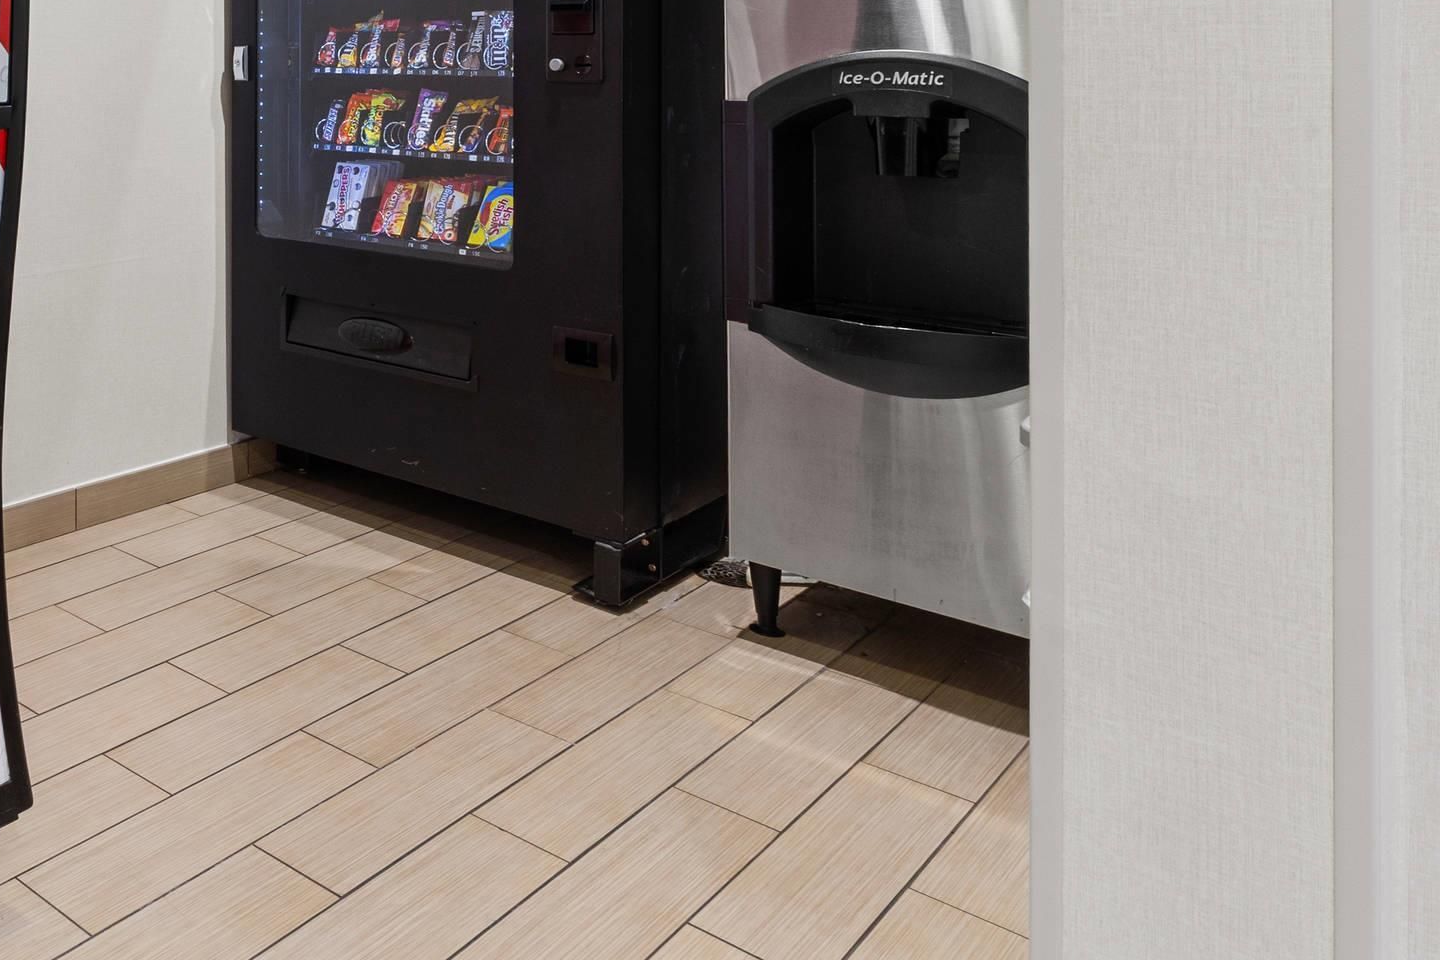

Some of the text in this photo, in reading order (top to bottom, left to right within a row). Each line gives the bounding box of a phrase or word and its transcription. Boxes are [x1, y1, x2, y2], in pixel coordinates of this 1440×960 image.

[839, 71, 945, 86] Ice-O-Matic
[334, 166, 351, 224] WHOPPERS
[435, 184, 454, 208] Dough
[487, 198, 509, 236] Swedish
[498, 206, 513, 228] Fish
